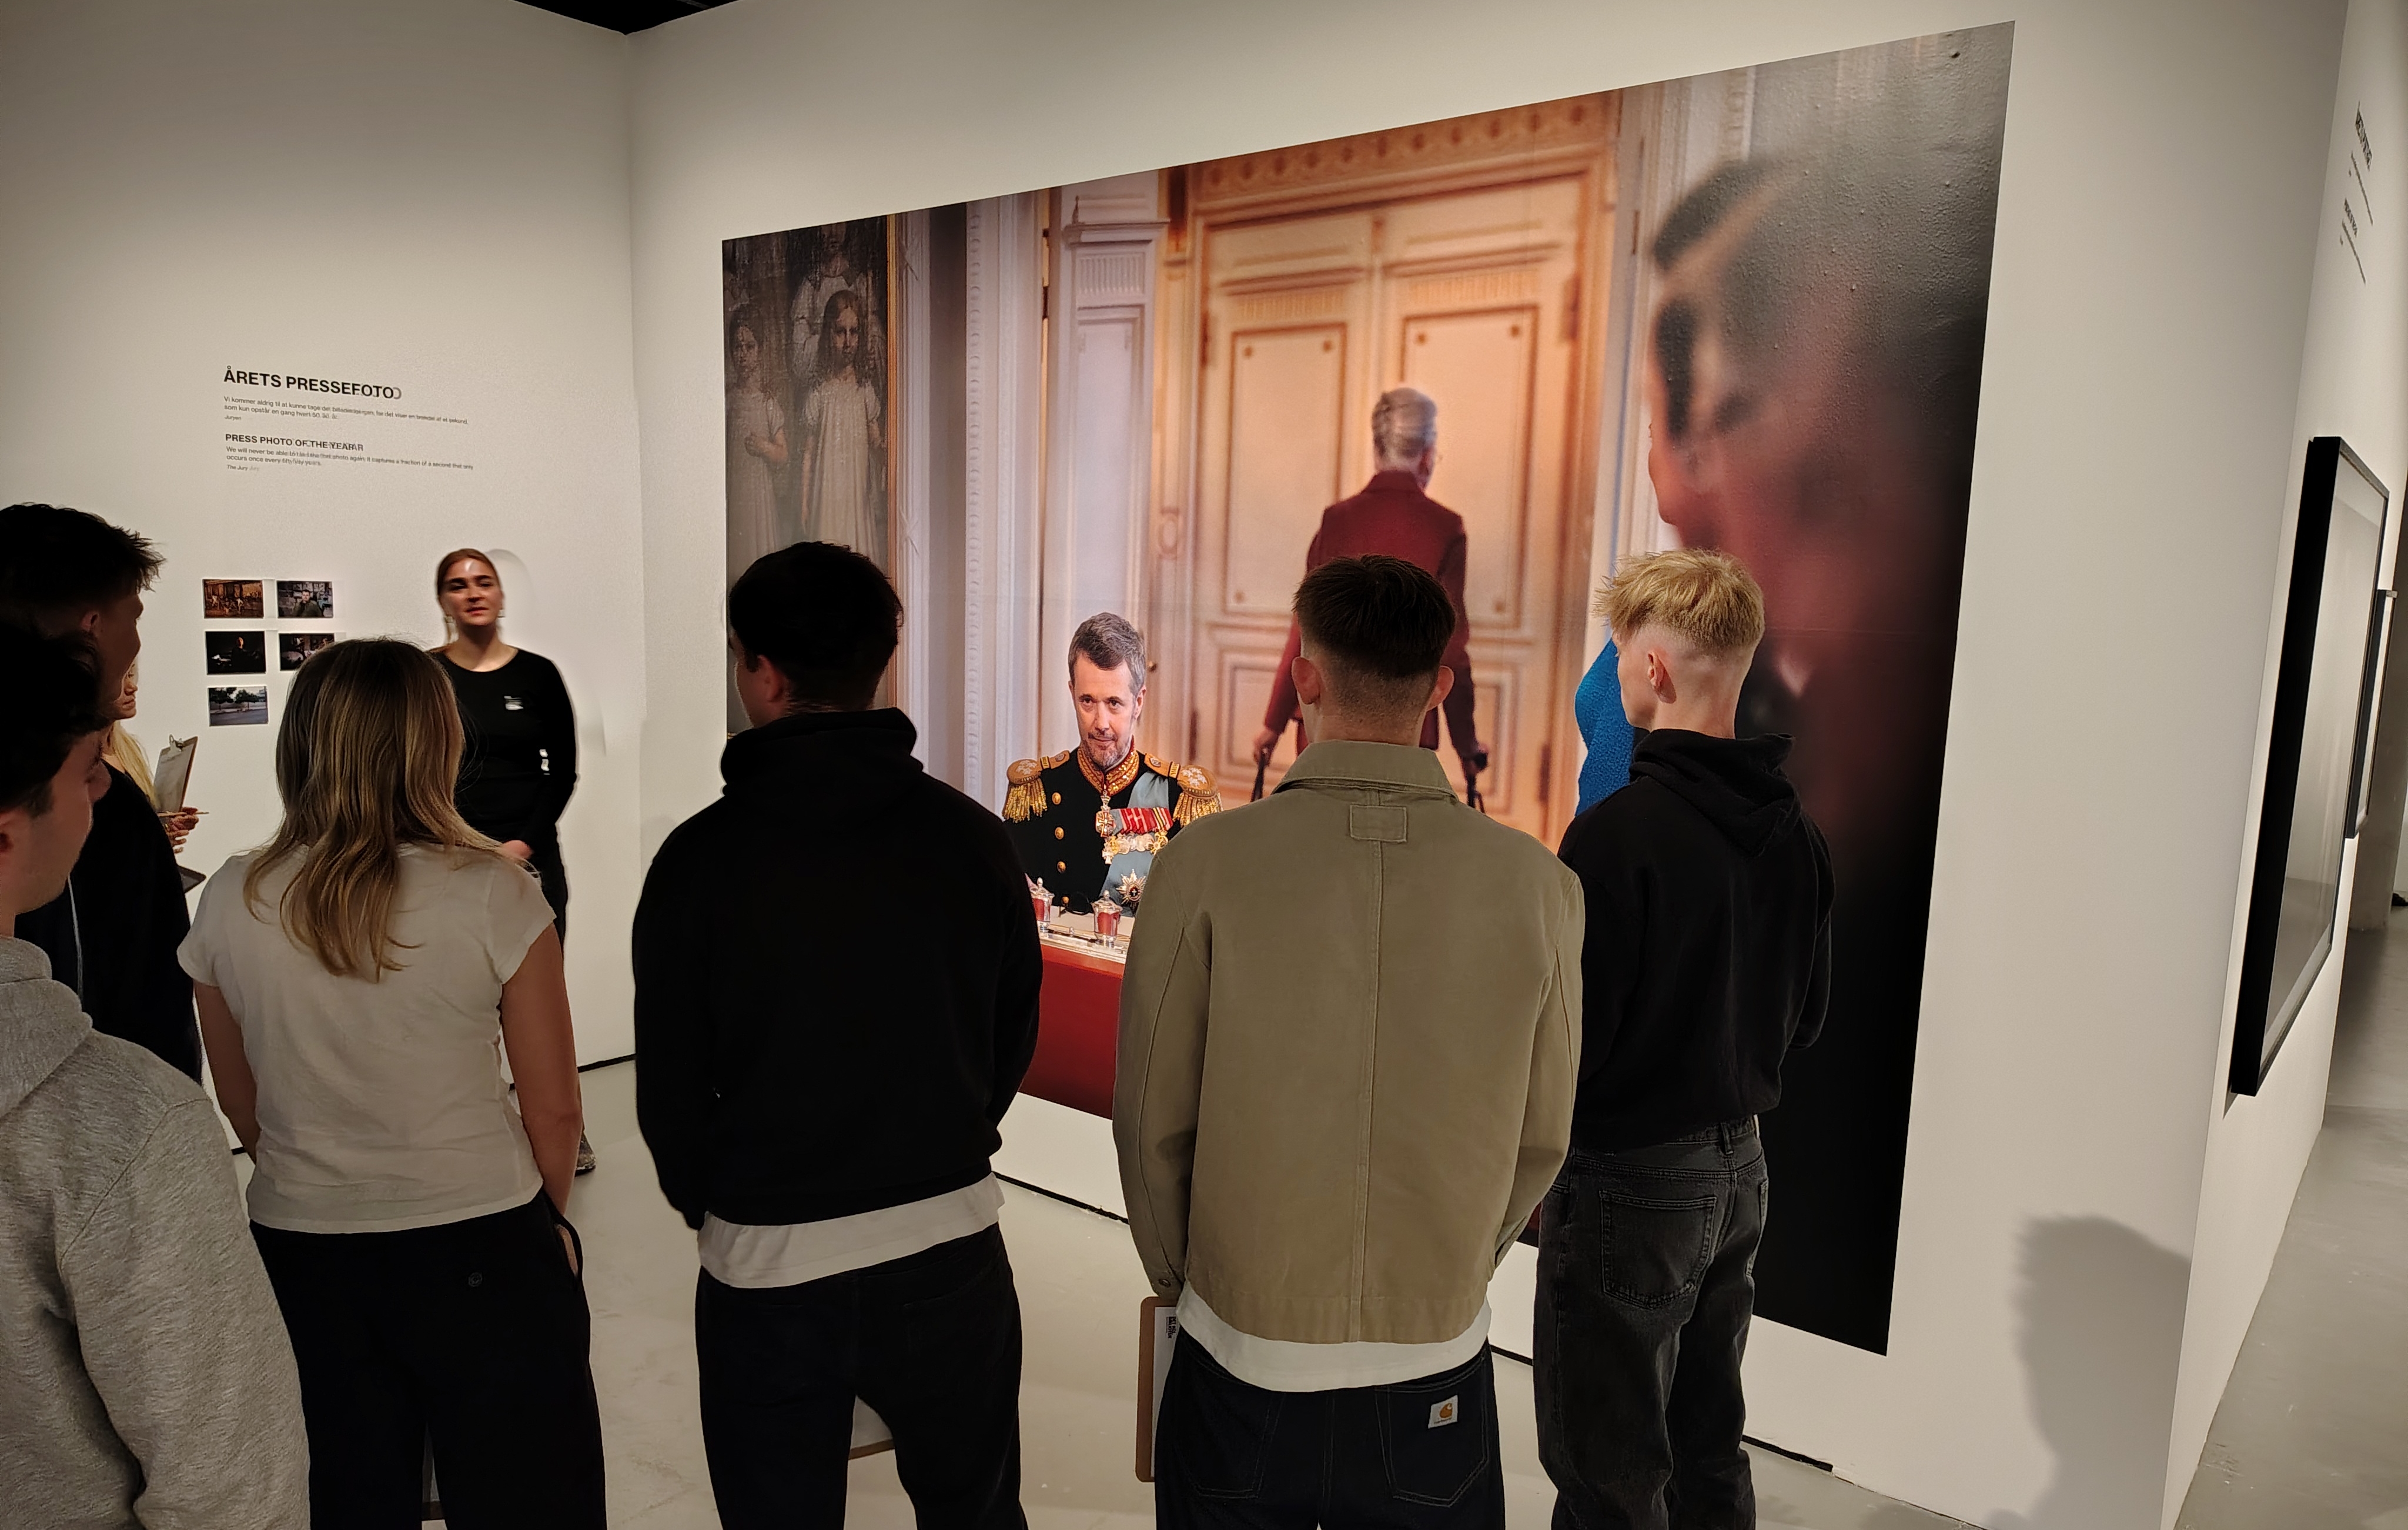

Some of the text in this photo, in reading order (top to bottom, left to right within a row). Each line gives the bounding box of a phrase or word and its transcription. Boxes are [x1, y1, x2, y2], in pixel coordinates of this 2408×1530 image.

[223, 365, 395, 399] ÅRETS PRESSEFOTO
[225, 433, 257, 443] PRESS
[260, 436, 292, 446] PHOTO
[295, 439, 307, 447] OF
[310, 440, 327, 449] THE
